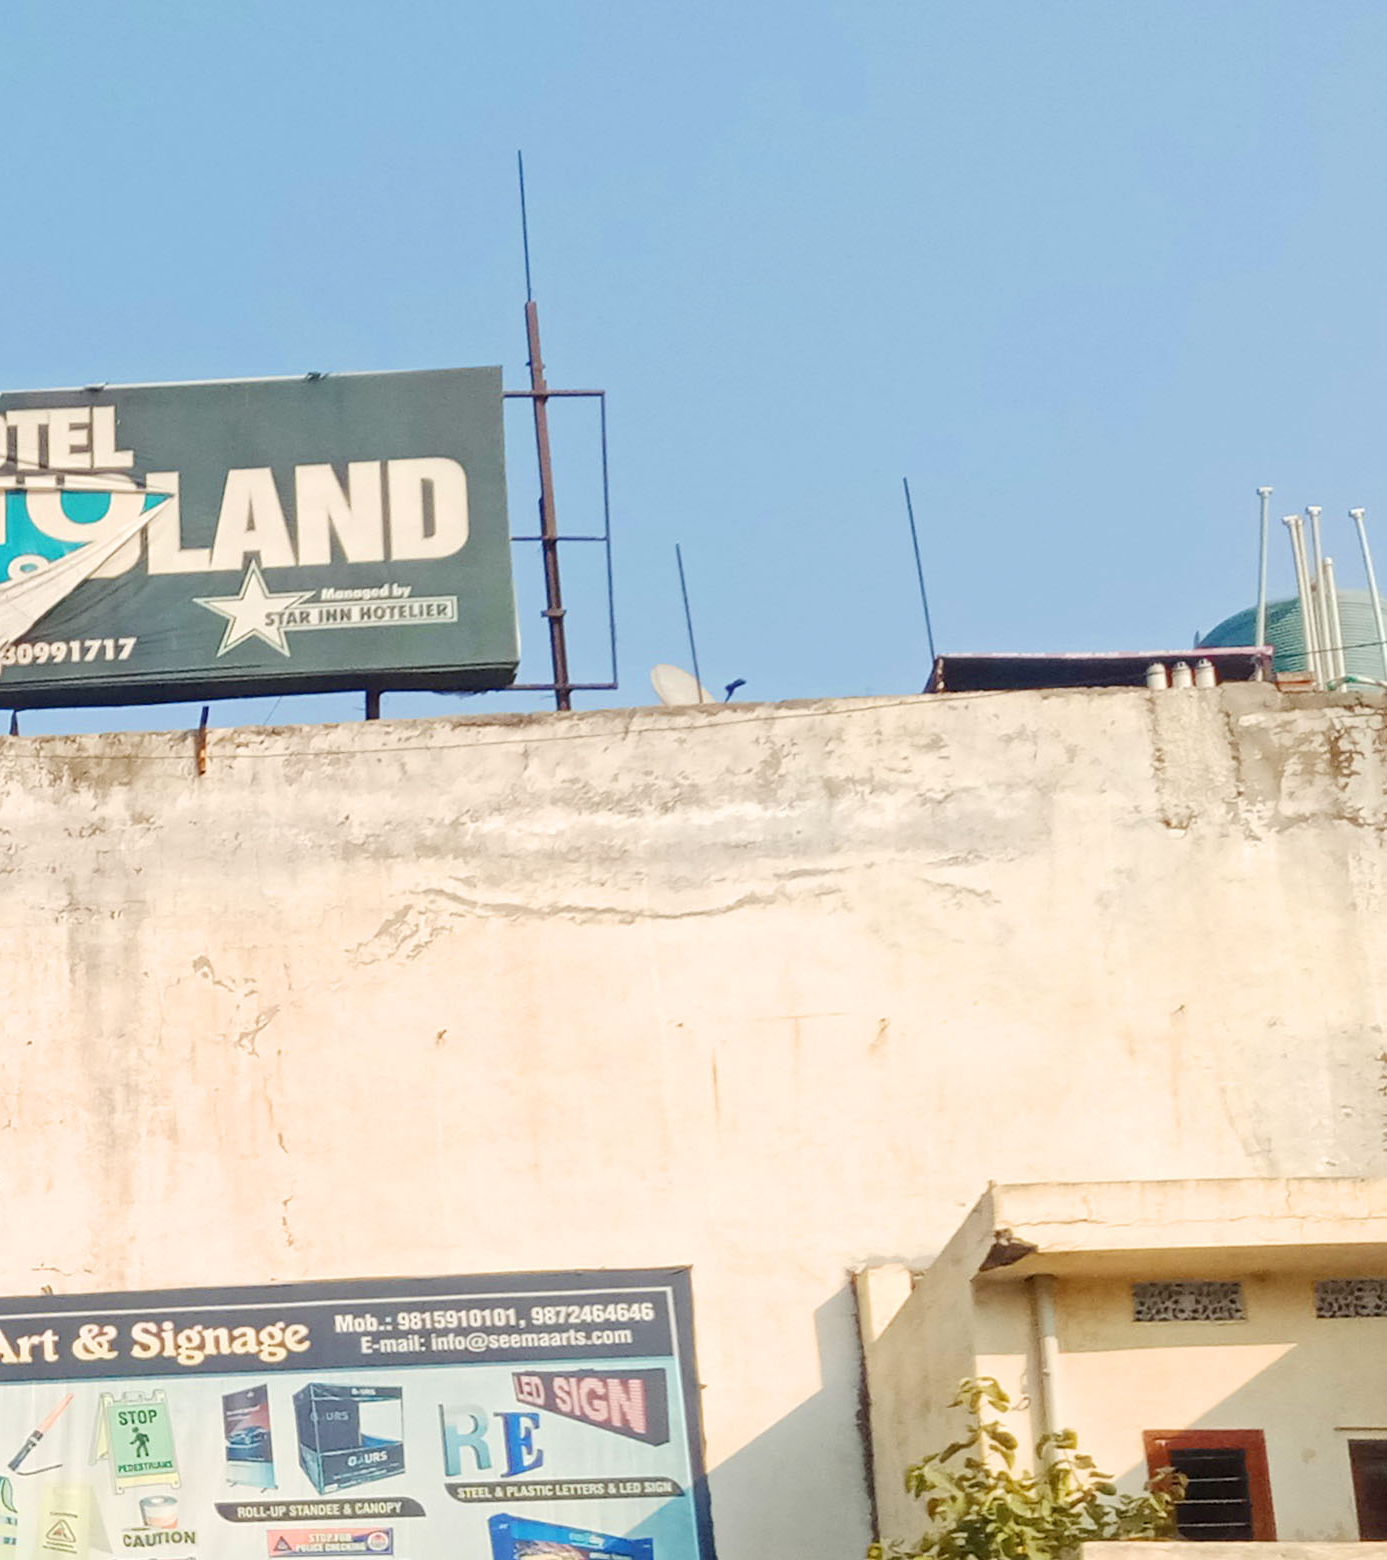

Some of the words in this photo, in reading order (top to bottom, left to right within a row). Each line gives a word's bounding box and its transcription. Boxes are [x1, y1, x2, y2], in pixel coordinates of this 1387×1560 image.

[320, 586, 390, 601] Managed
[392, 583, 412, 599] by
[264, 610, 311, 627] STAR
[318, 609, 353, 624] INN
[359, 603, 449, 621] HOTELIER
[334, 1312, 393, 1335] Mob.:
[396, 1307, 527, 1331] 9815910101,
[531, 1302, 655, 1326] 9872464646
[71, 1323, 119, 1361] &
[129, 1320, 312, 1366] Signage
[361, 1335, 427, 1356] E-mail:
[430, 1328, 634, 1353] info@seemaarts.com
[554, 1374, 647, 1436] SIGN
[118, 1409, 158, 1426] STOP
[457, 1485, 491, 1499] STEEL
[495, 1484, 504, 1498] &
[507, 1483, 554, 1498] PLASTIC
[556, 1481, 605, 1497] LETTERS
[608, 1481, 617, 1495] &
[620, 1481, 642, 1495] LED
[644, 1480, 674, 1494] SIGN
[237, 1506, 288, 1519] ROLL-UP
[289, 1503, 341, 1517] STANDEE
[343, 1502, 352, 1515] &
[355, 1501, 402, 1515] CANOPY
[123, 1530, 197, 1549] CAUTION
